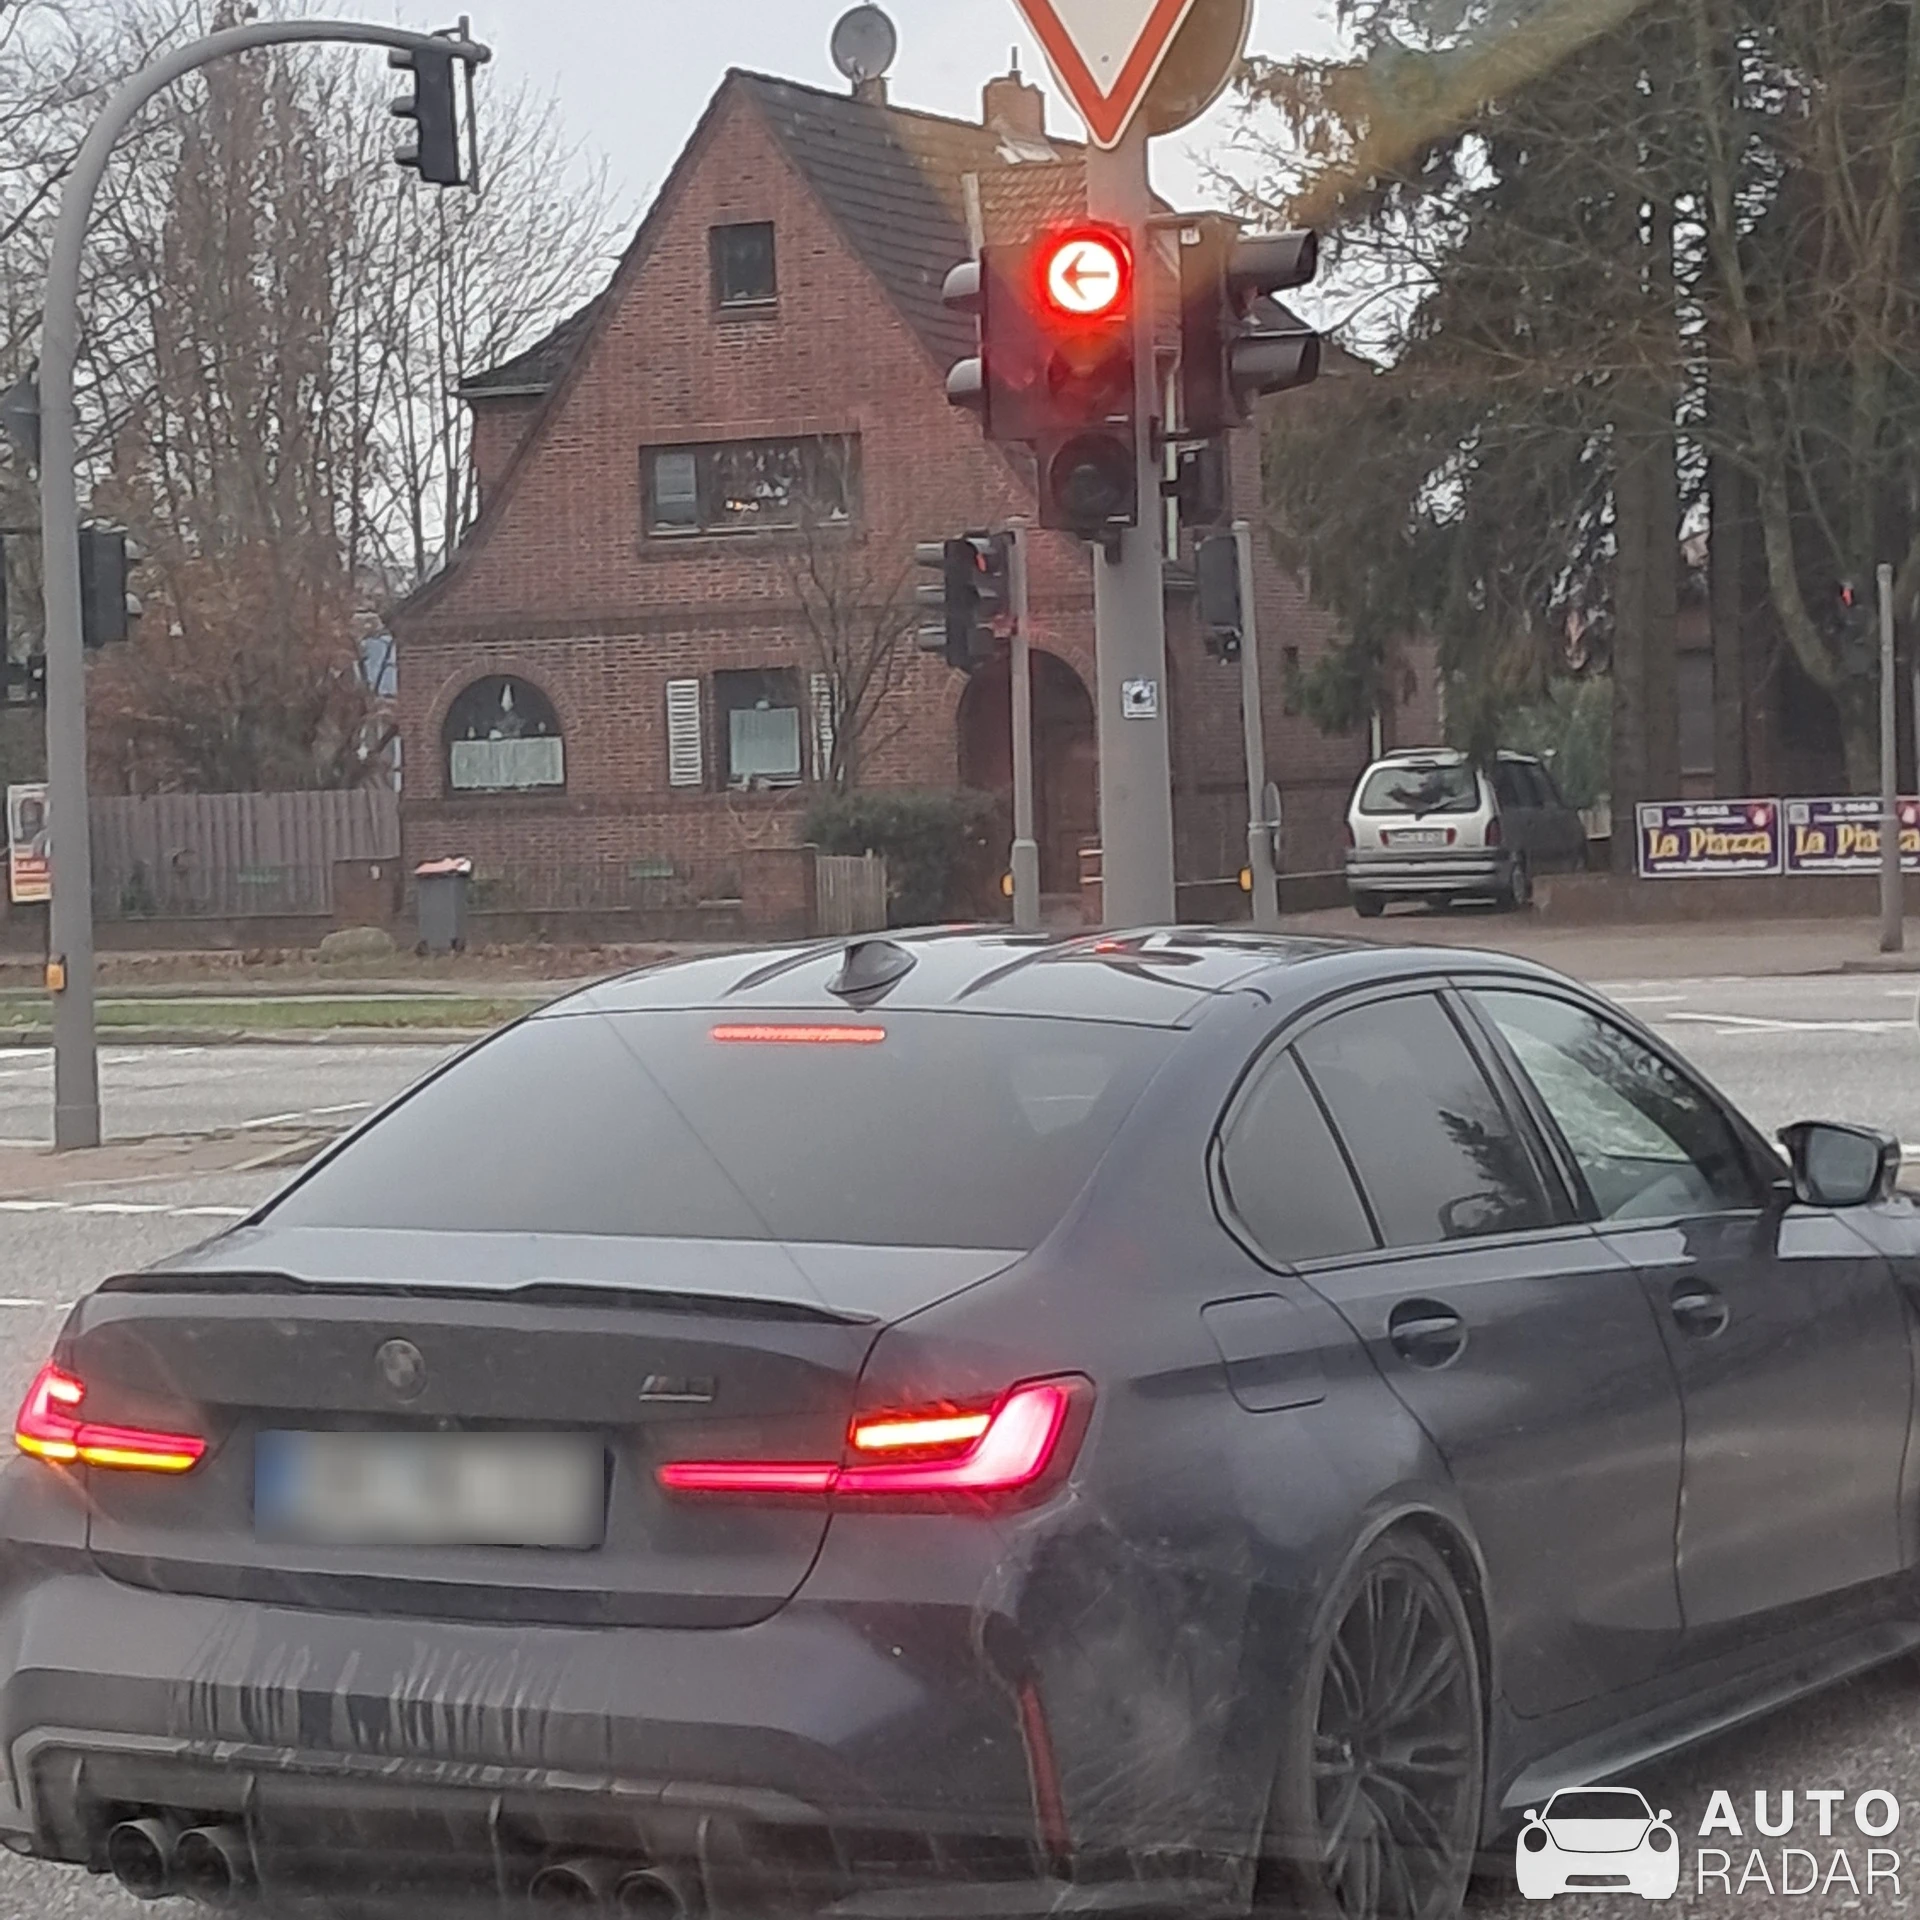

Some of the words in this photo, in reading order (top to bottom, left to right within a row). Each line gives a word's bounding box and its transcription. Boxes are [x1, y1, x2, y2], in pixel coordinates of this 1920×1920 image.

[1648, 829, 1680, 859] La
[1688, 827, 1771, 858] Piazza
[1794, 825, 1826, 856] La
[1836, 823, 1920, 856] Piaa
